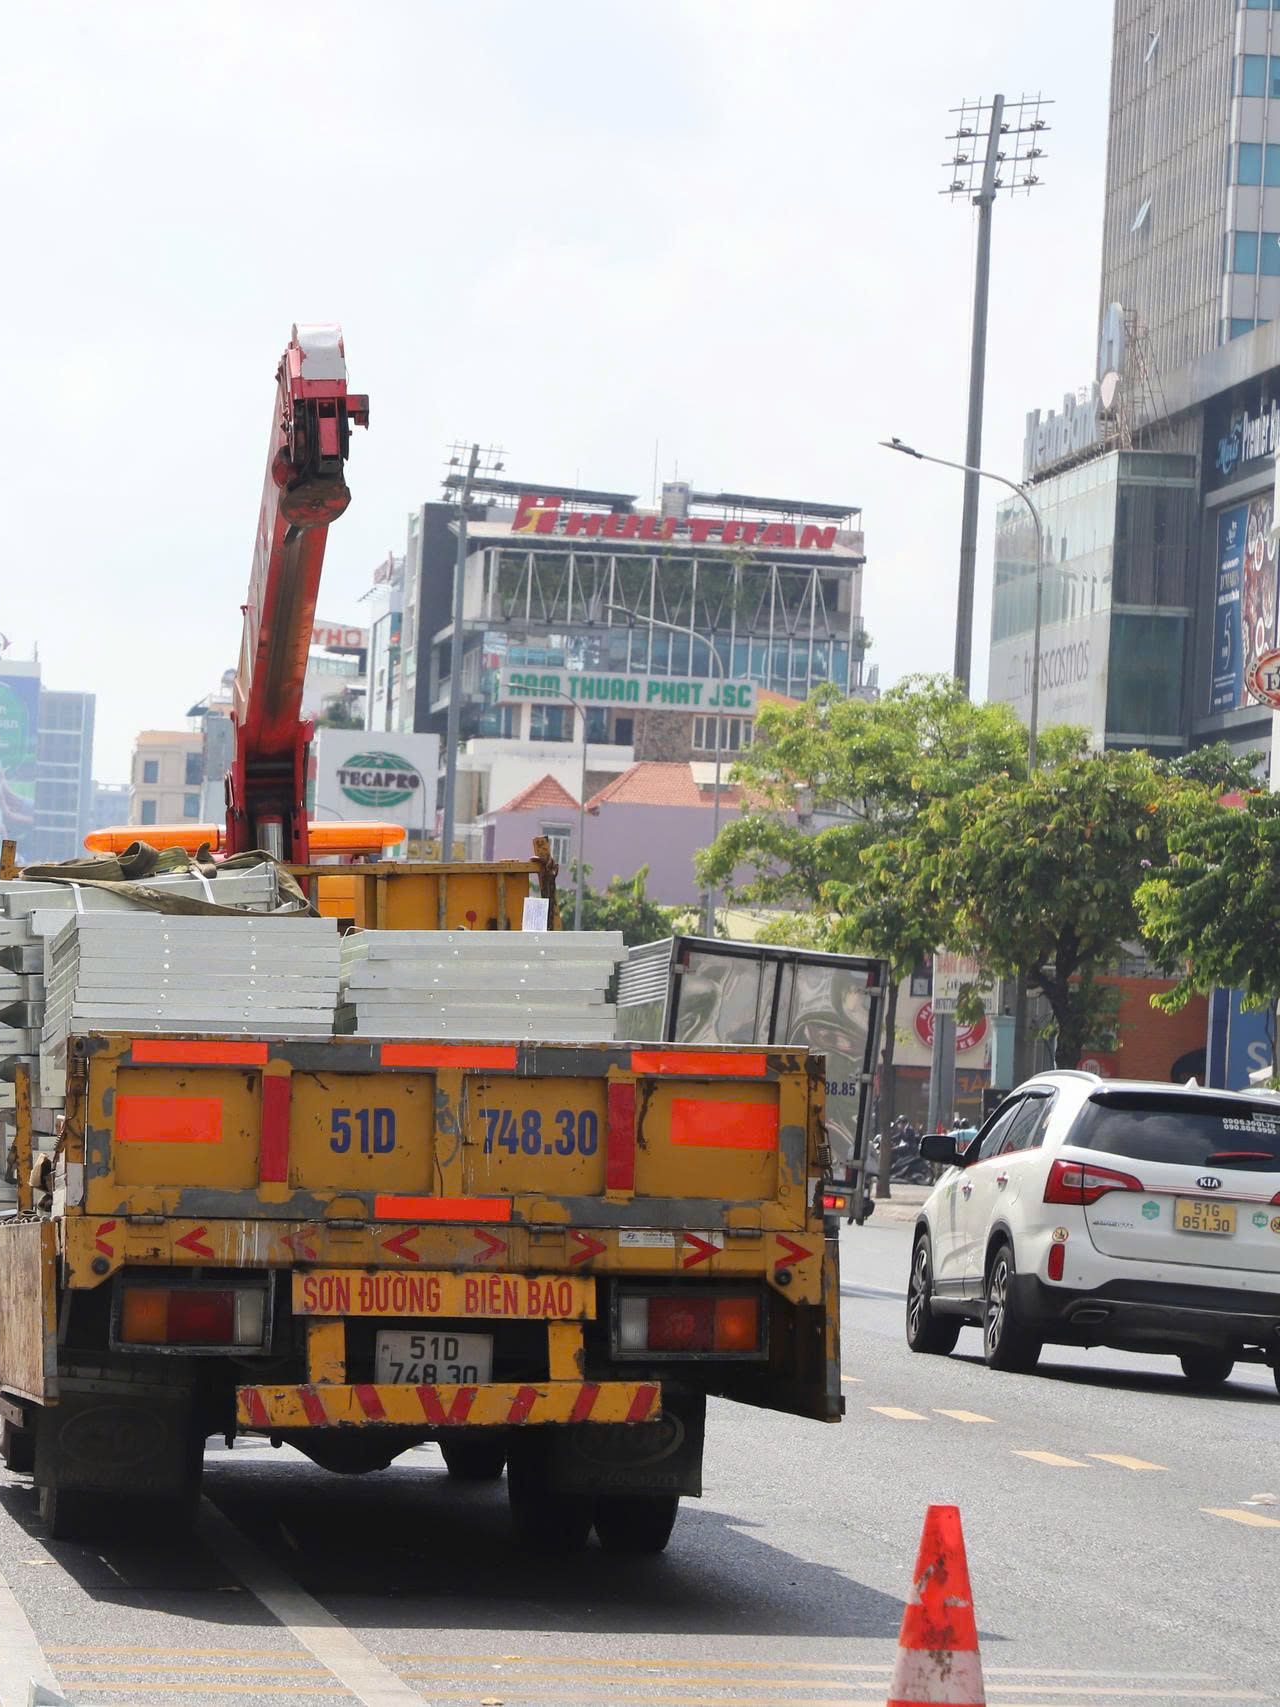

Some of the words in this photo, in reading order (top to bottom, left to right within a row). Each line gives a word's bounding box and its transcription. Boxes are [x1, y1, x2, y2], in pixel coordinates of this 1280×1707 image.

[336, 770, 420, 789] TECAPRO
[329, 1107, 396, 1155] 51D
[479, 1108, 599, 1156] 748.30
[1199, 1177, 1219, 1187] KIA
[1193, 1203, 1220, 1217] 51G
[1182, 1216, 1231, 1233] 851.30
[303, 1274, 351, 1312] SƠN
[358, 1271, 441, 1313] ĐƯỜNG
[410, 1335, 459, 1361] 51D
